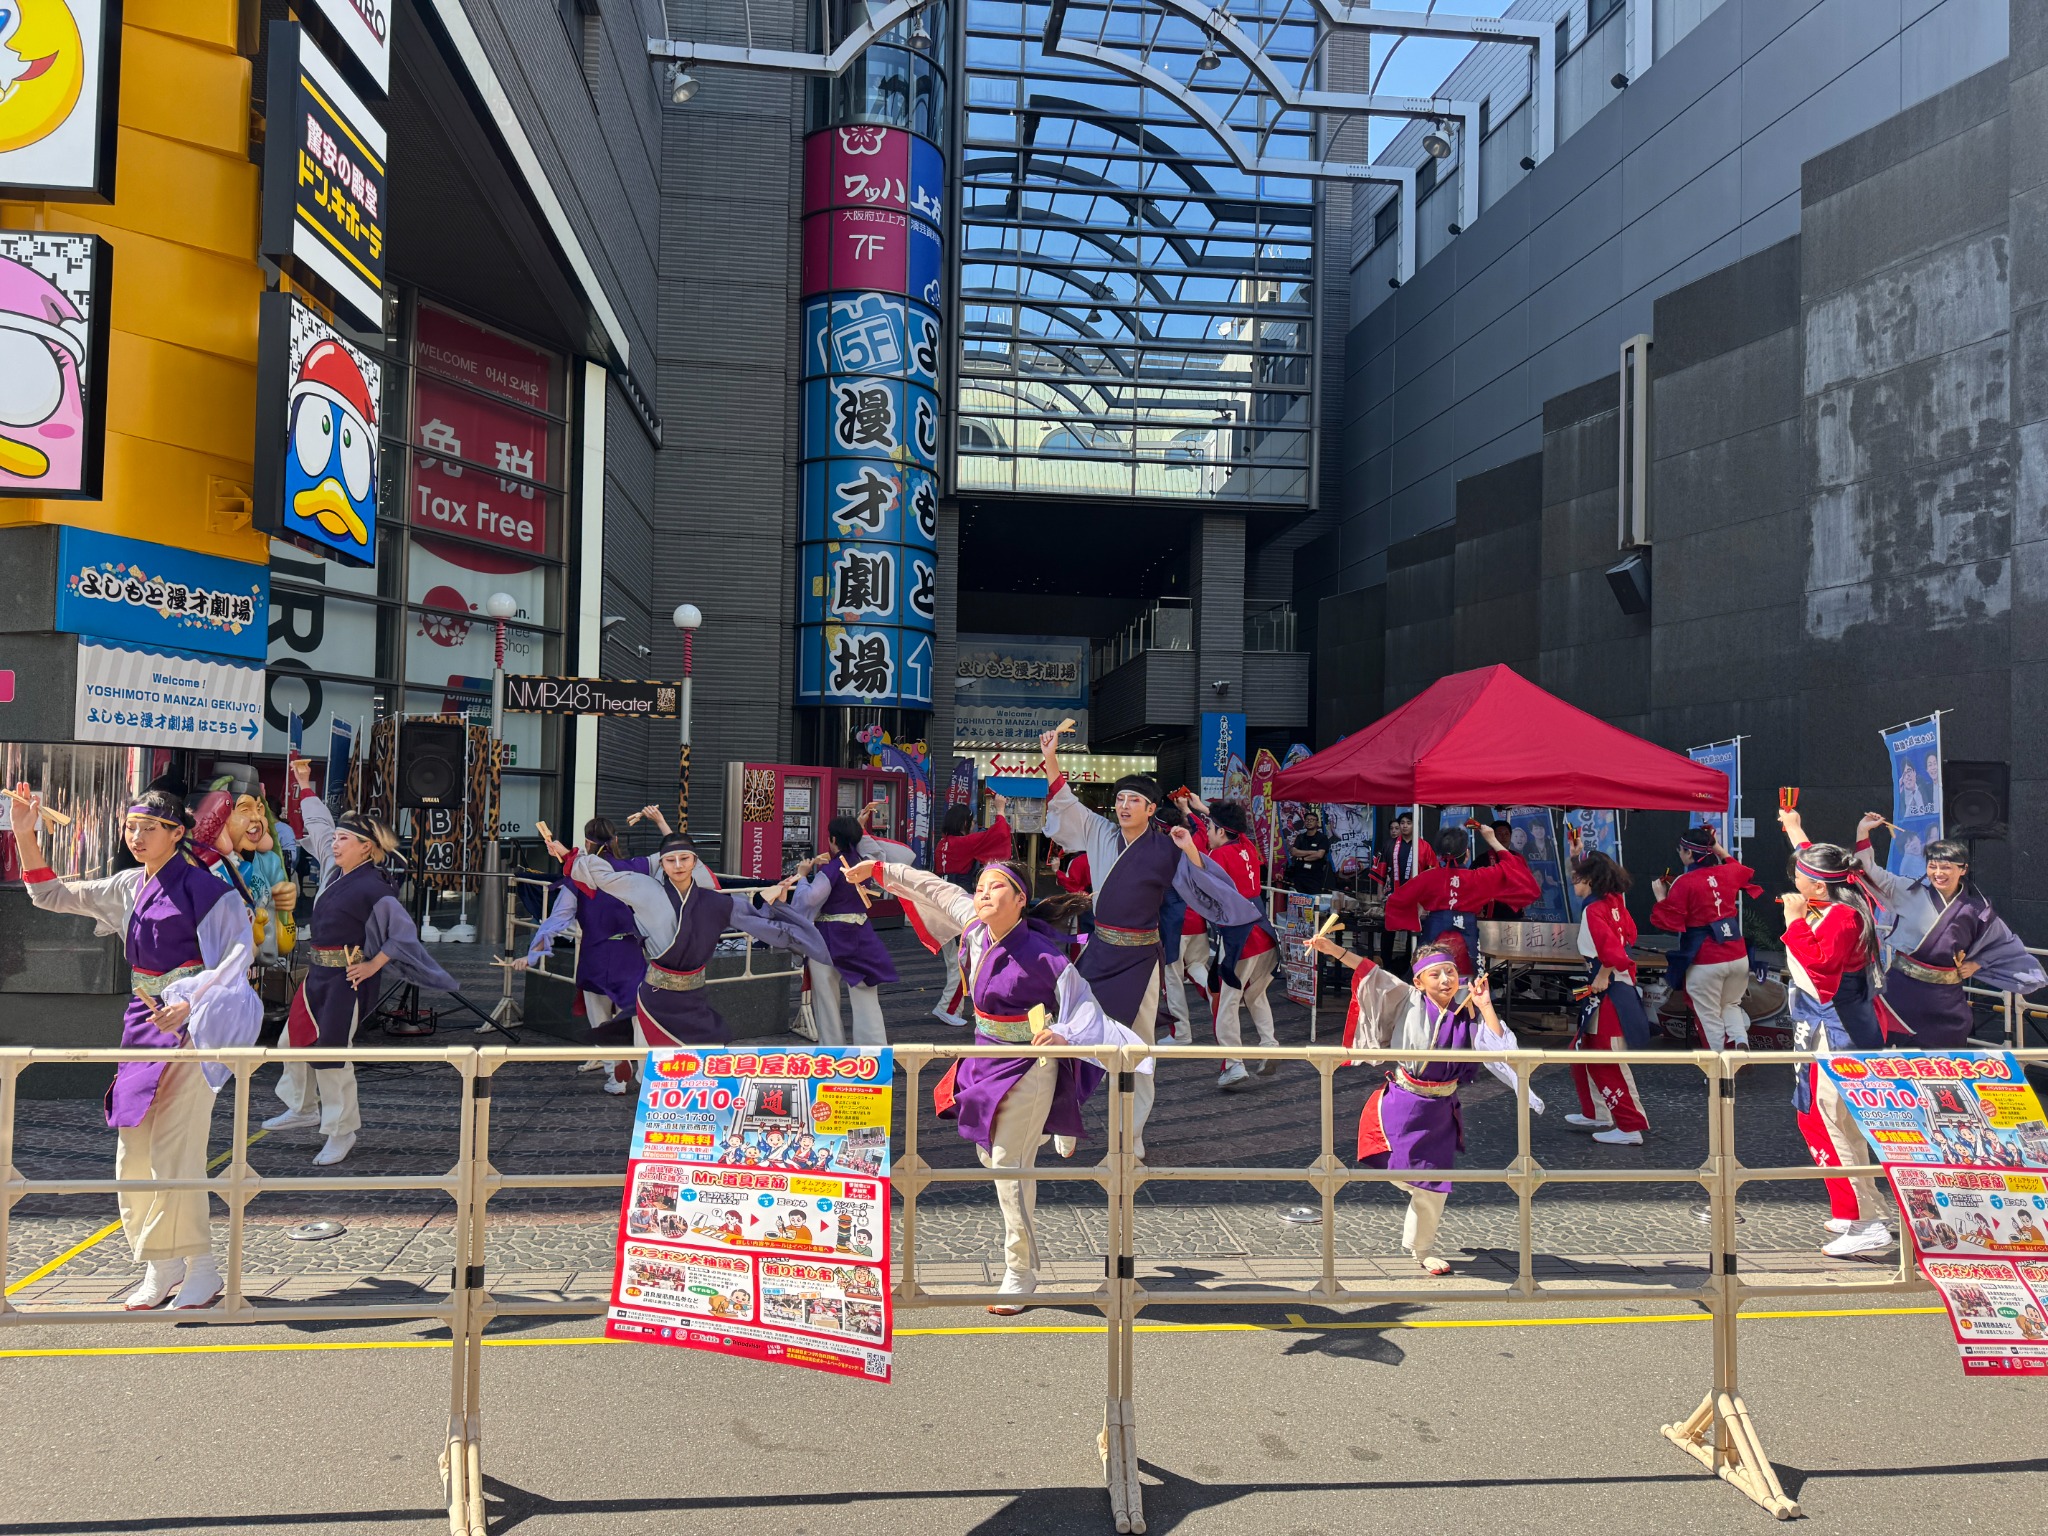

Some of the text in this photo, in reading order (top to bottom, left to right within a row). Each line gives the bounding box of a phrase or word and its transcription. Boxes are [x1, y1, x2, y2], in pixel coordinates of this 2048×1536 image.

[306, 113, 379, 219] 驚安の殿堂
[849, 234, 886, 260] 7F
[843, 315, 893, 368] 5F
[417, 341, 479, 374] WELCOME
[417, 485, 534, 542] Tax Free
[81, 571, 252, 623] よしもと漫才劇場
[957, 659, 1077, 681] よしもと漫才劇場
[86, 685, 160, 702] YOSHIMOTO
[163, 693, 208, 708] MANZAI
[508, 681, 591, 709] NMB48
[592, 693, 653, 712] Theater
[744, 769, 776, 790] NMB
[744, 789, 766, 808] 48
[662, 1060, 697, 1073] 第41回
[704, 1053, 879, 1079] 道具屋筋まつり
[1867, 1058, 2011, 1080] 道具屋筋まつり
[648, 1089, 732, 1110] 10/10
[1847, 1090, 1917, 1109] 10/10
[648, 1132, 713, 1146] 参加無料
[1874, 1130, 1927, 1144] 参加無料
[693, 1170, 788, 1191] Mr.道具屋筋
[796, 1179, 838, 1188] タイムアタック
[1934, 1172, 2006, 1191] Mr.道具屋筋
[628, 1246, 750, 1273] ガラポン大抽選会
